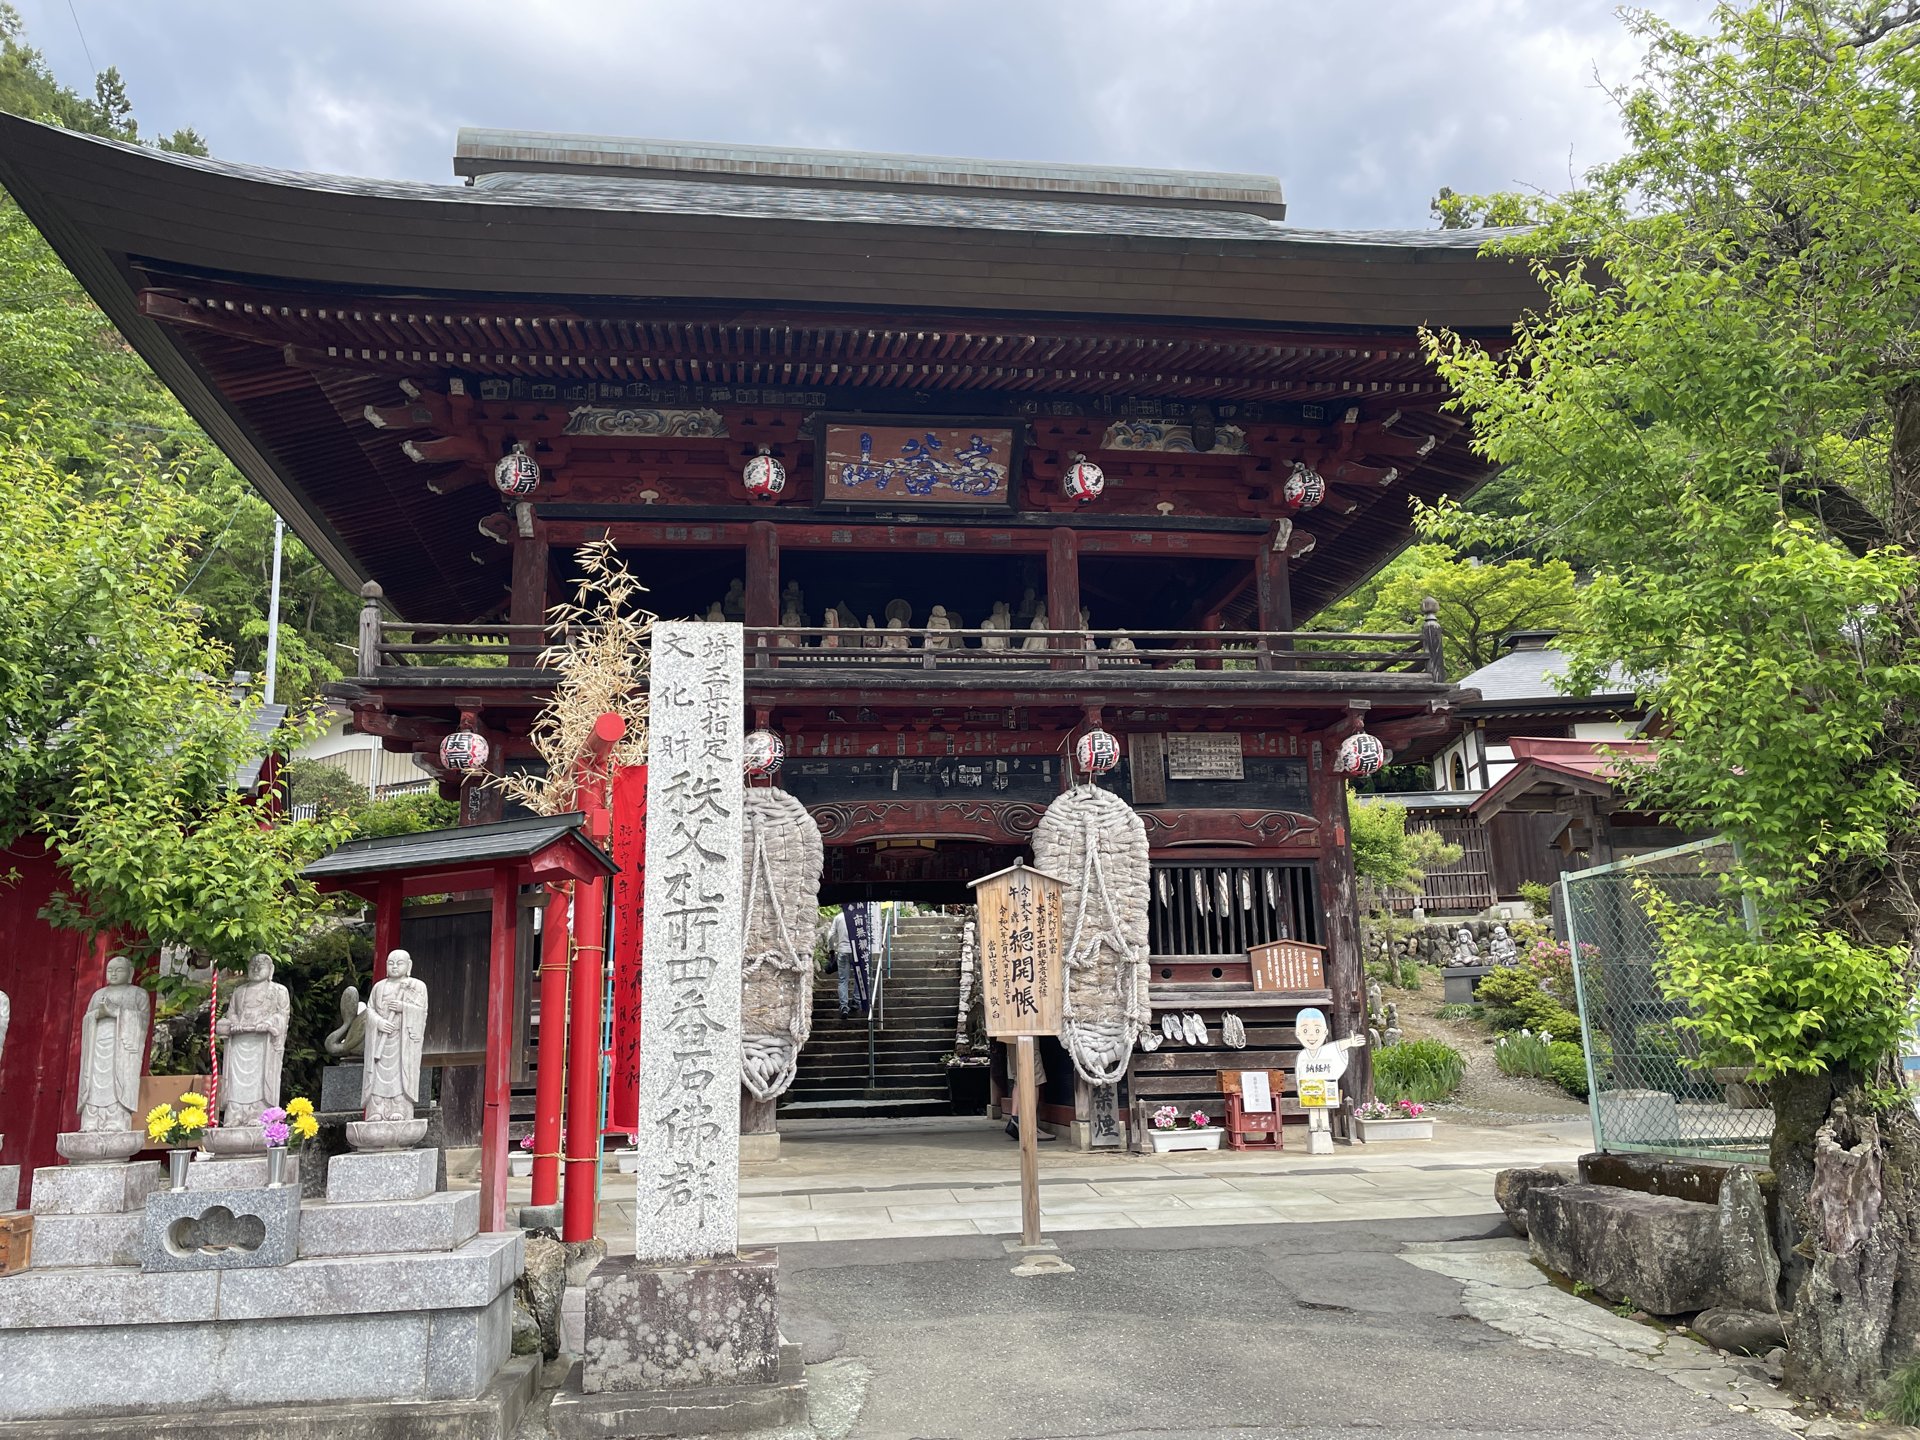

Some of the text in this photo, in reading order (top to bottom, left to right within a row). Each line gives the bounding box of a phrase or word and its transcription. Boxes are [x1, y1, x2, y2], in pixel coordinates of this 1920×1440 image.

[657, 632, 695, 763] 文化財
[699, 632, 735, 763] 埼玉県指定
[446, 734, 473, 768] 開扉
[1092, 733, 1115, 768] 開扉
[1357, 736, 1380, 771] 開扉
[1020, 884, 1033, 922] 令和八年
[654, 764, 731, 1229] 秩父札所四番石佛群
